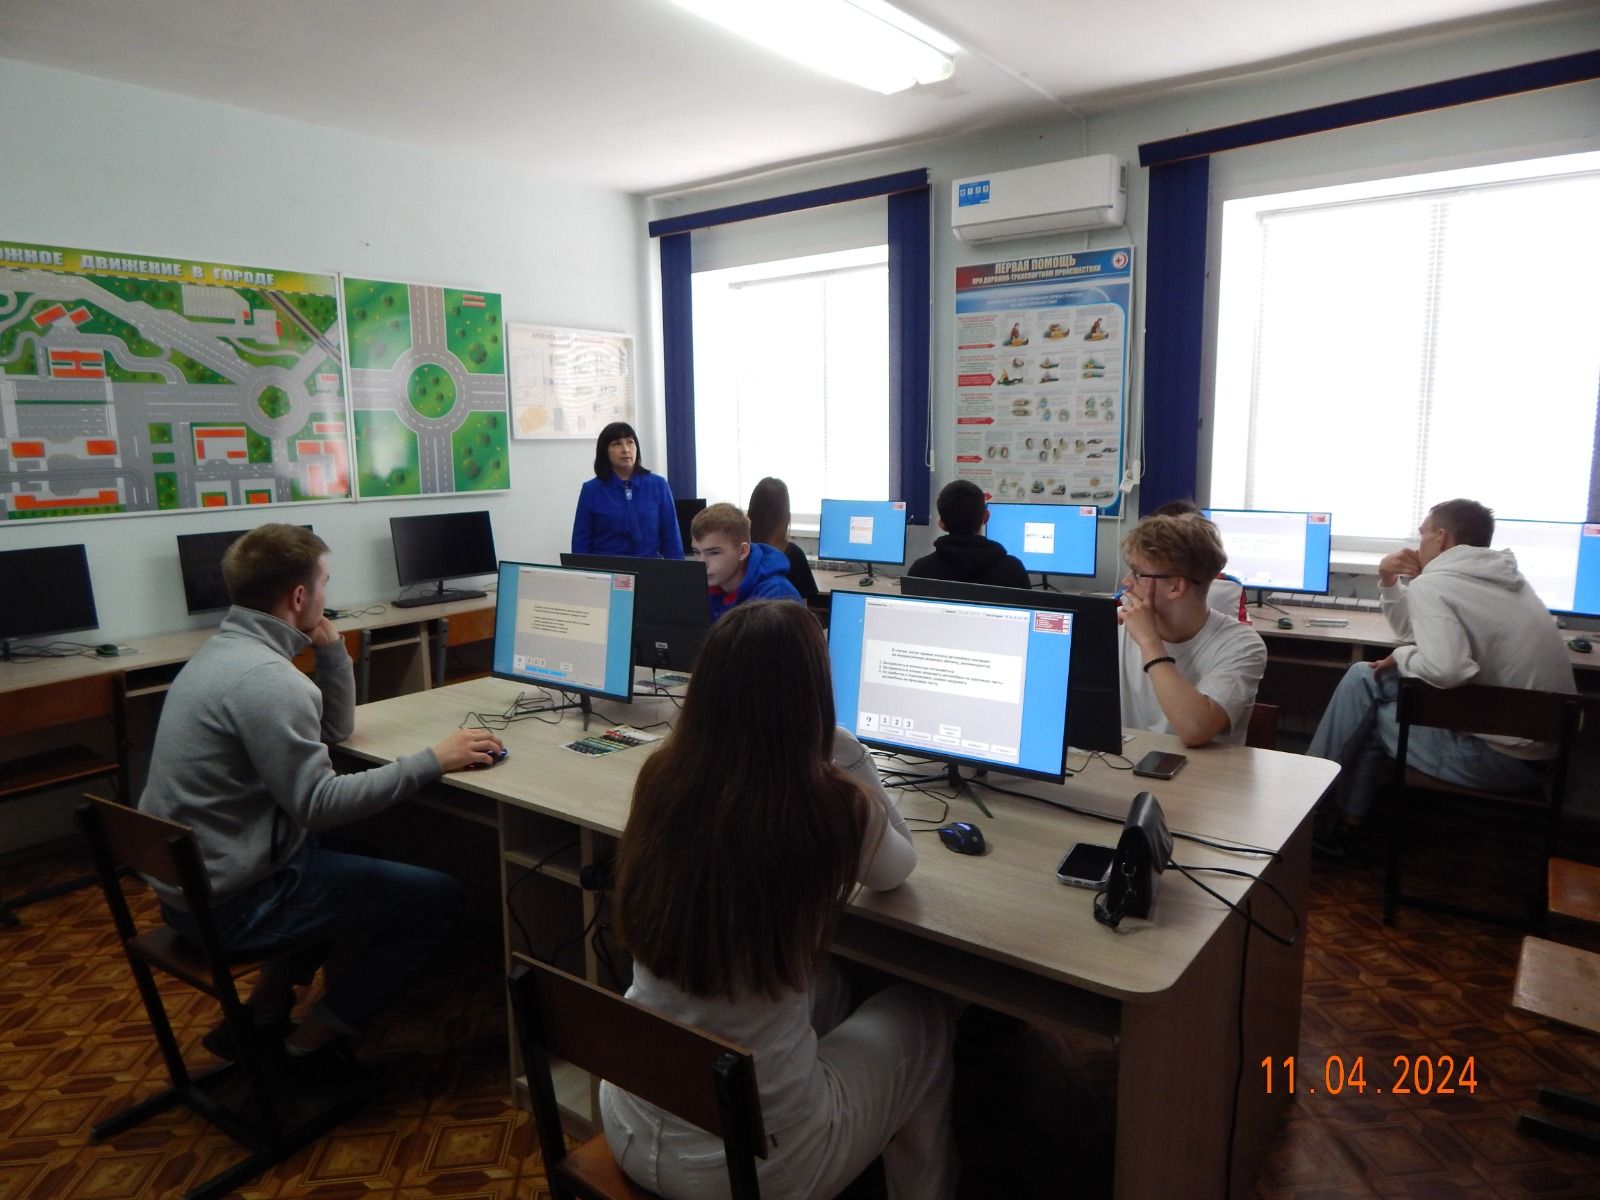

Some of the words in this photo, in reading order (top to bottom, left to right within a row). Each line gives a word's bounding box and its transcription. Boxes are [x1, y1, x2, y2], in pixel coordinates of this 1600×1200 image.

[81, 254, 182, 276] ДВИЖЕНИЕ
[192, 265, 204, 279] В
[213, 267, 275, 286] ГОРОДЕ
[994, 259, 1030, 274] ПЕРВАЯ
[1031, 254, 1076, 271] ПОМОЩЬ
